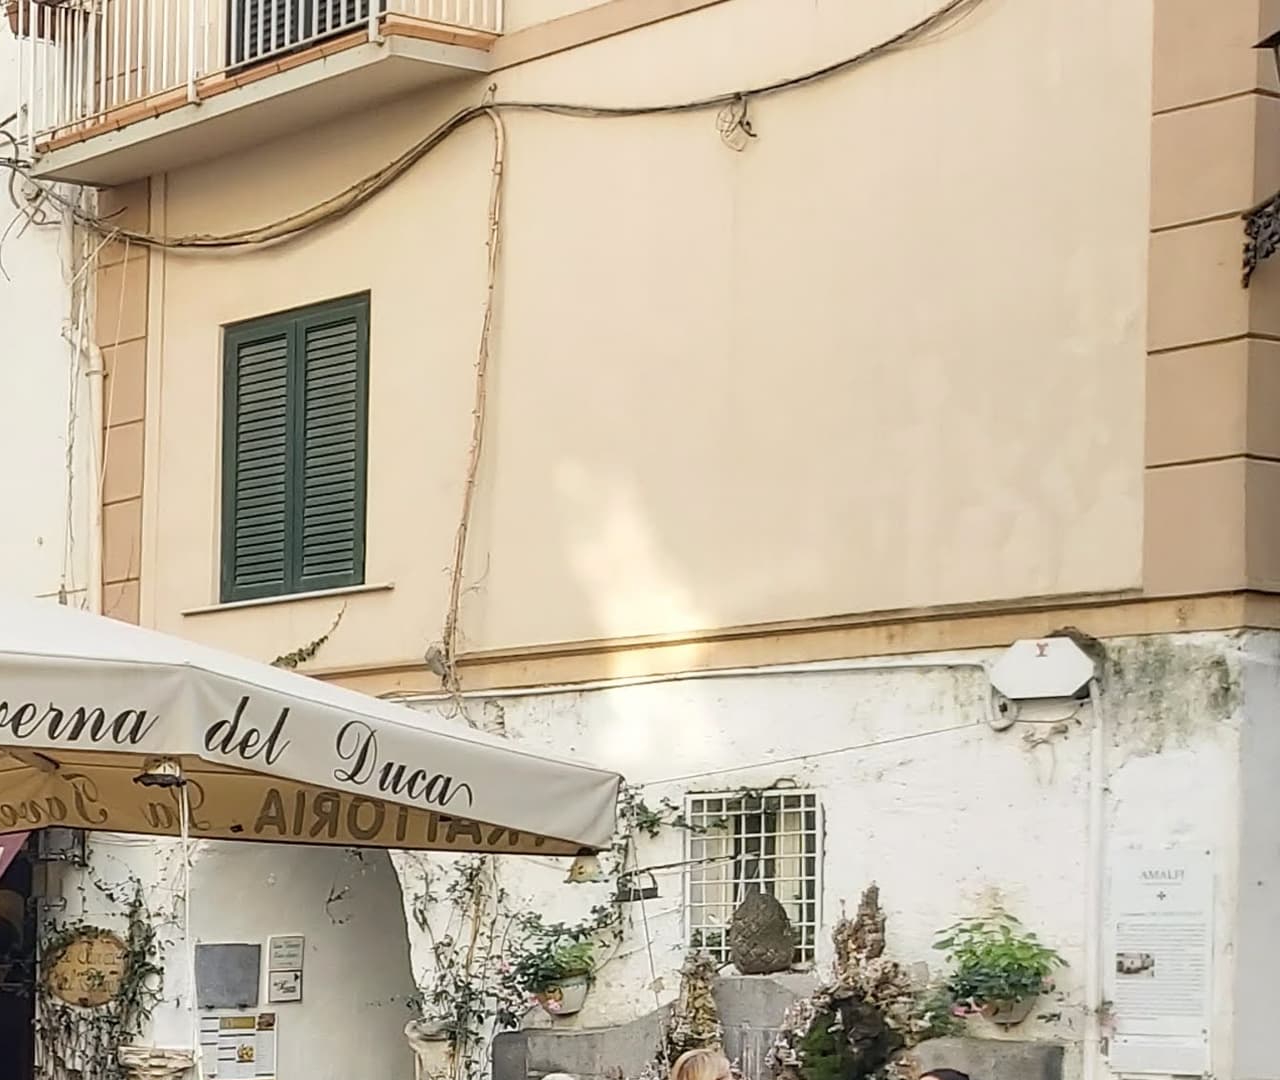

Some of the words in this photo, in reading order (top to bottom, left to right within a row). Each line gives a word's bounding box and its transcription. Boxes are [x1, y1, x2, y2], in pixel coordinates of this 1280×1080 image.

[203, 695, 290, 766] del
[334, 720, 473, 808] Duca
[1140, 869, 1185, 881] AMALFI
